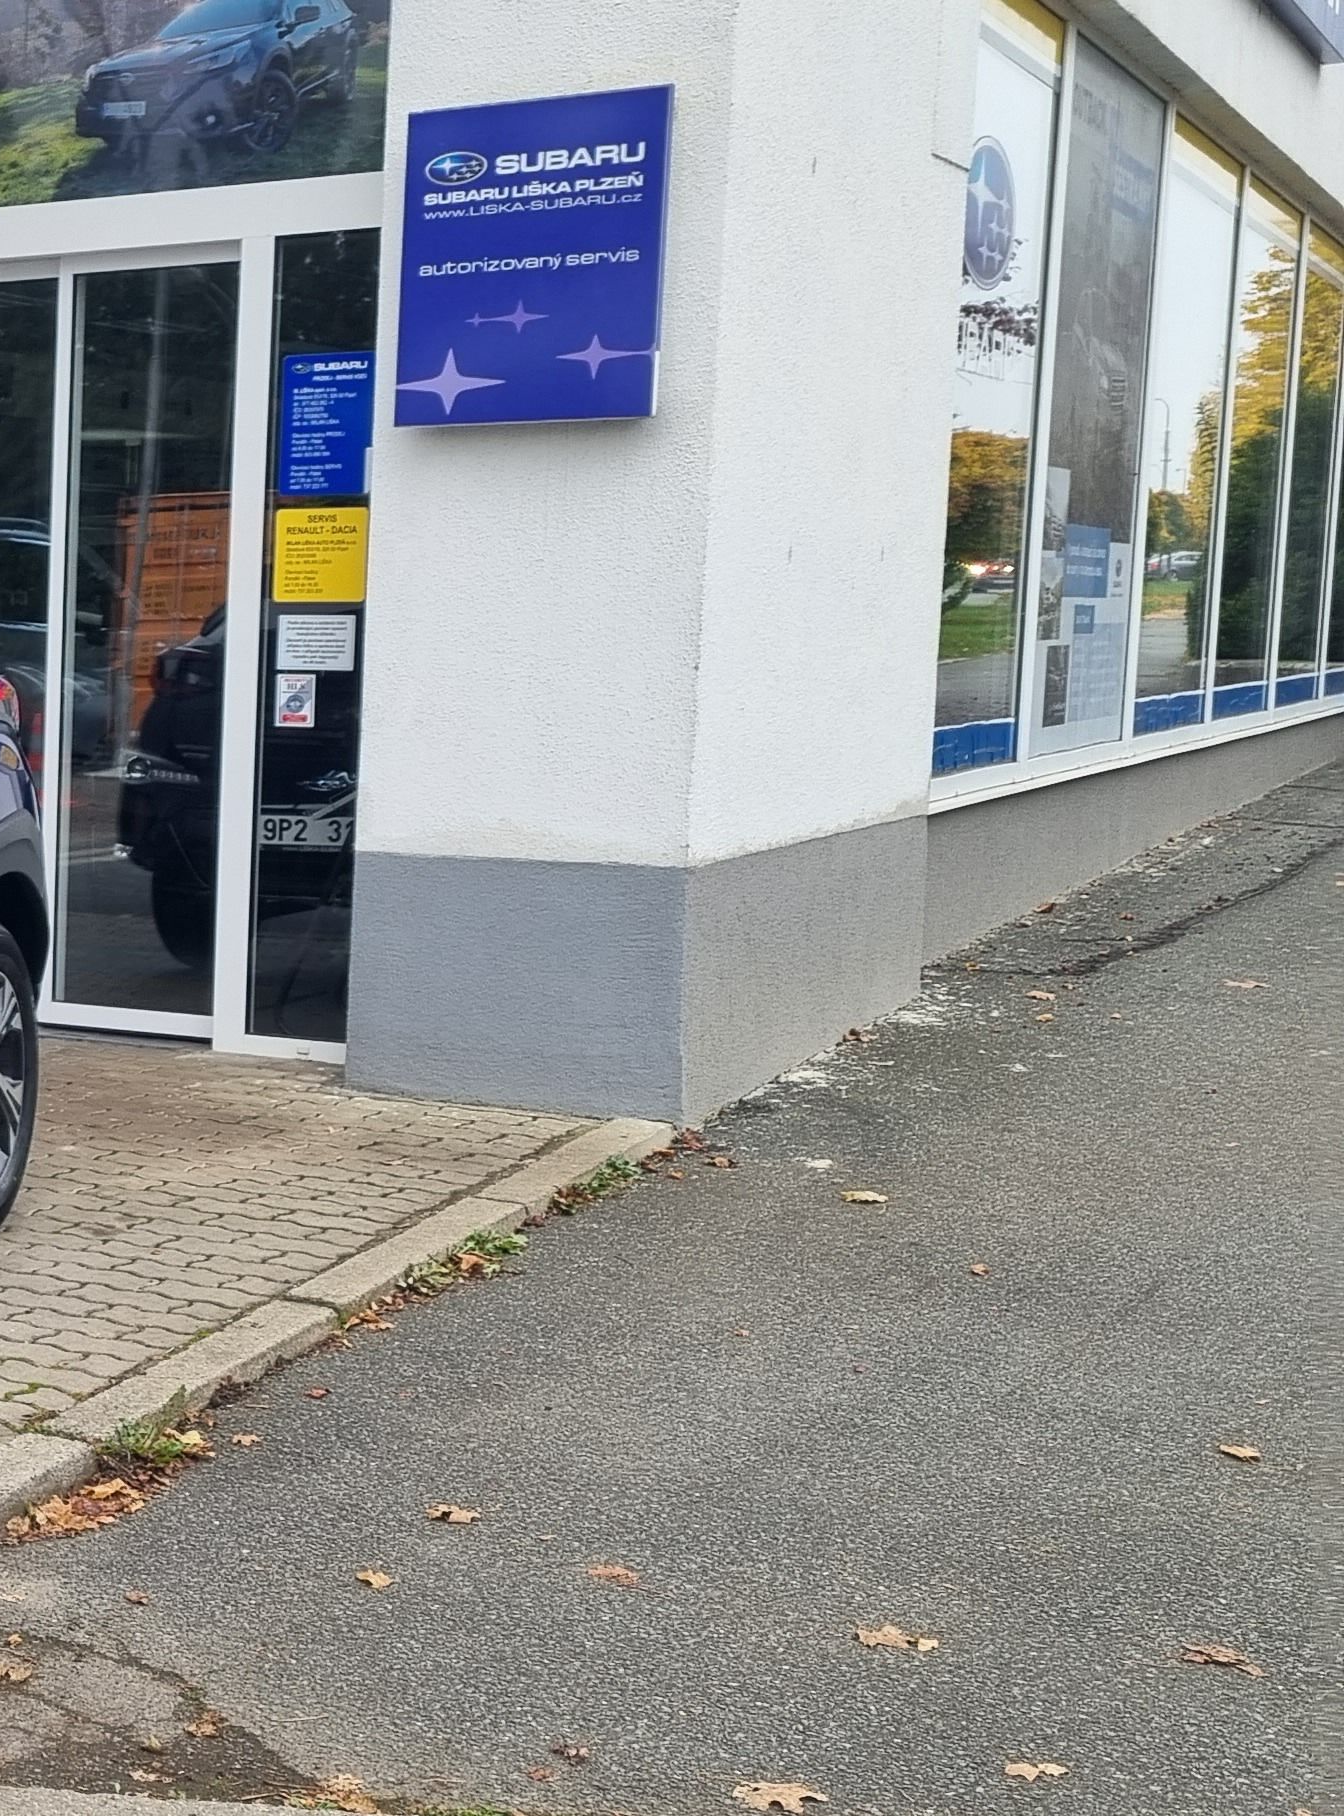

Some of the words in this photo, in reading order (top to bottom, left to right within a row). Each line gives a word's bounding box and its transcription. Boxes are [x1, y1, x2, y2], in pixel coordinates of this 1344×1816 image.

[494, 141, 646, 175] SUBARU
[423, 186, 509, 205] SUBARU
[512, 181, 571, 198] LIŠKA
[574, 171, 643, 192] PLZEŇ
[423, 193, 643, 220] www.LISKA-SUBARU.cz
[418, 252, 562, 277] autorizovaný
[565, 246, 640, 267] servis
[313, 361, 368, 372] SUBARU
[286, 525, 324, 535] RENAULT
[331, 525, 358, 534] DACIA
[307, 514, 338, 523] SERVIS
[263, 818, 308, 842] 9P2
